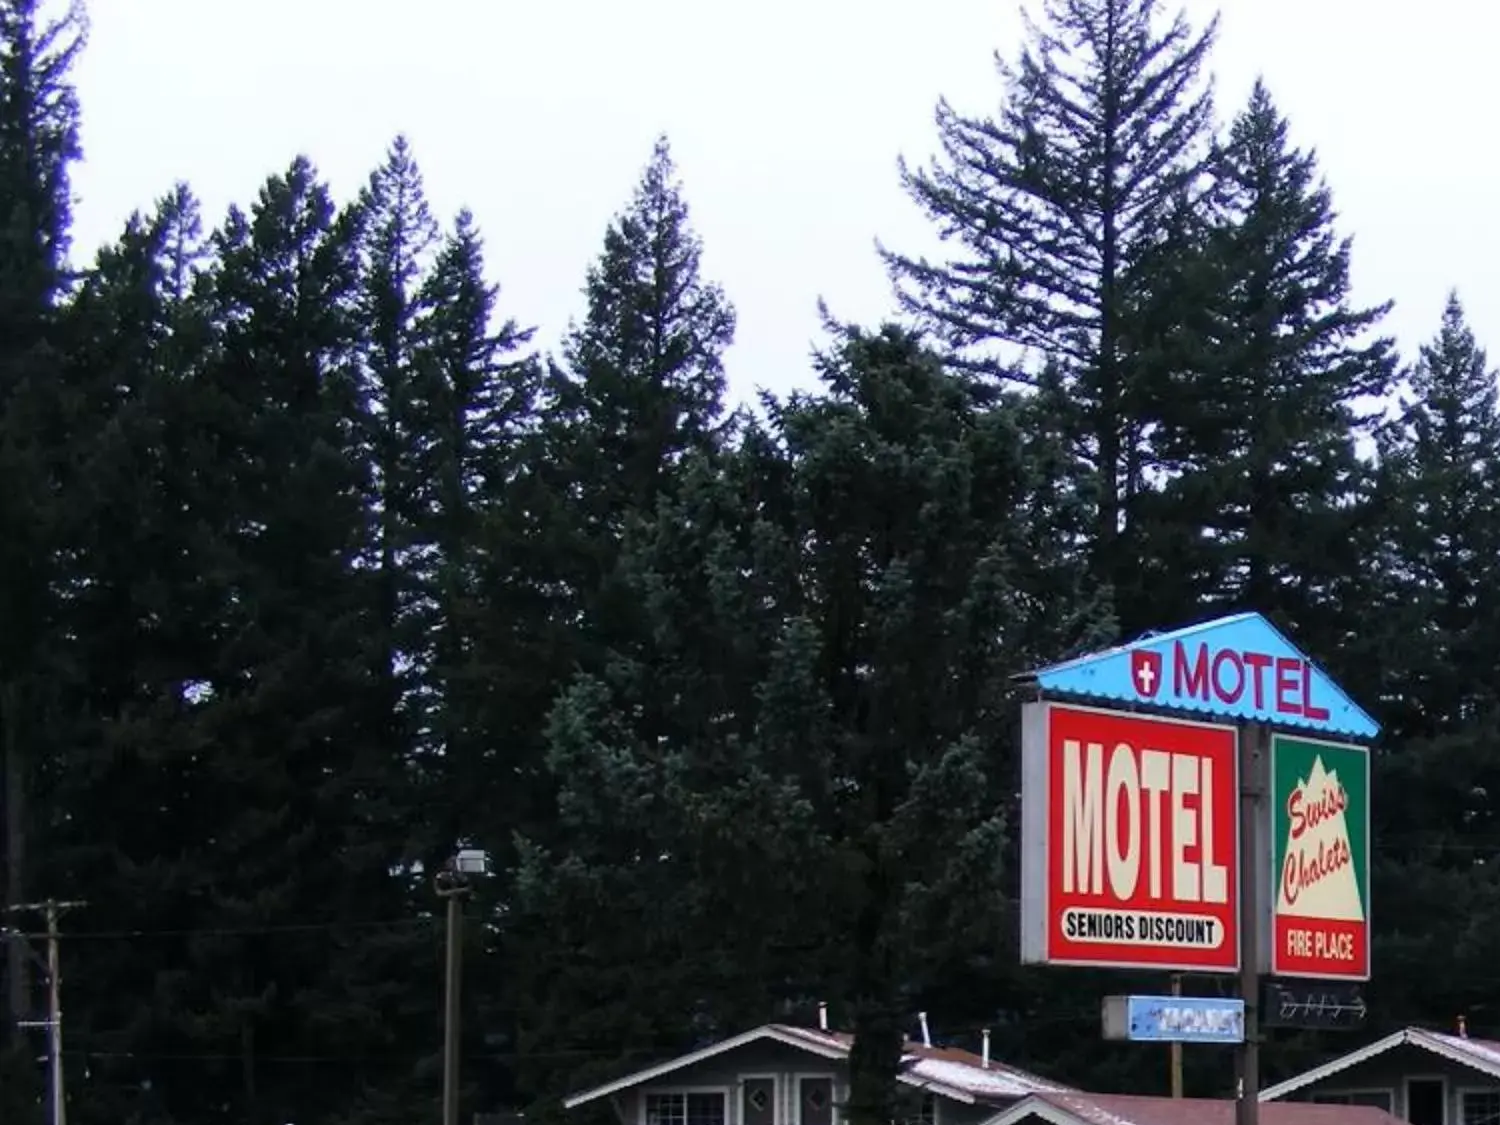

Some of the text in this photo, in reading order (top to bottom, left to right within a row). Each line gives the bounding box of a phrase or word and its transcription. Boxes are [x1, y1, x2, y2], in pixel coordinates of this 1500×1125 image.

[1174, 641, 1329, 721] MOTEL
[1063, 740, 1227, 903] MOTEL
[1289, 785, 1346, 840] Swiss
[1284, 838, 1350, 905] Chalets
[1067, 911, 1214, 944] SENIORS DISCOUNT
[1287, 929, 1354, 961] FIRE PLACE
